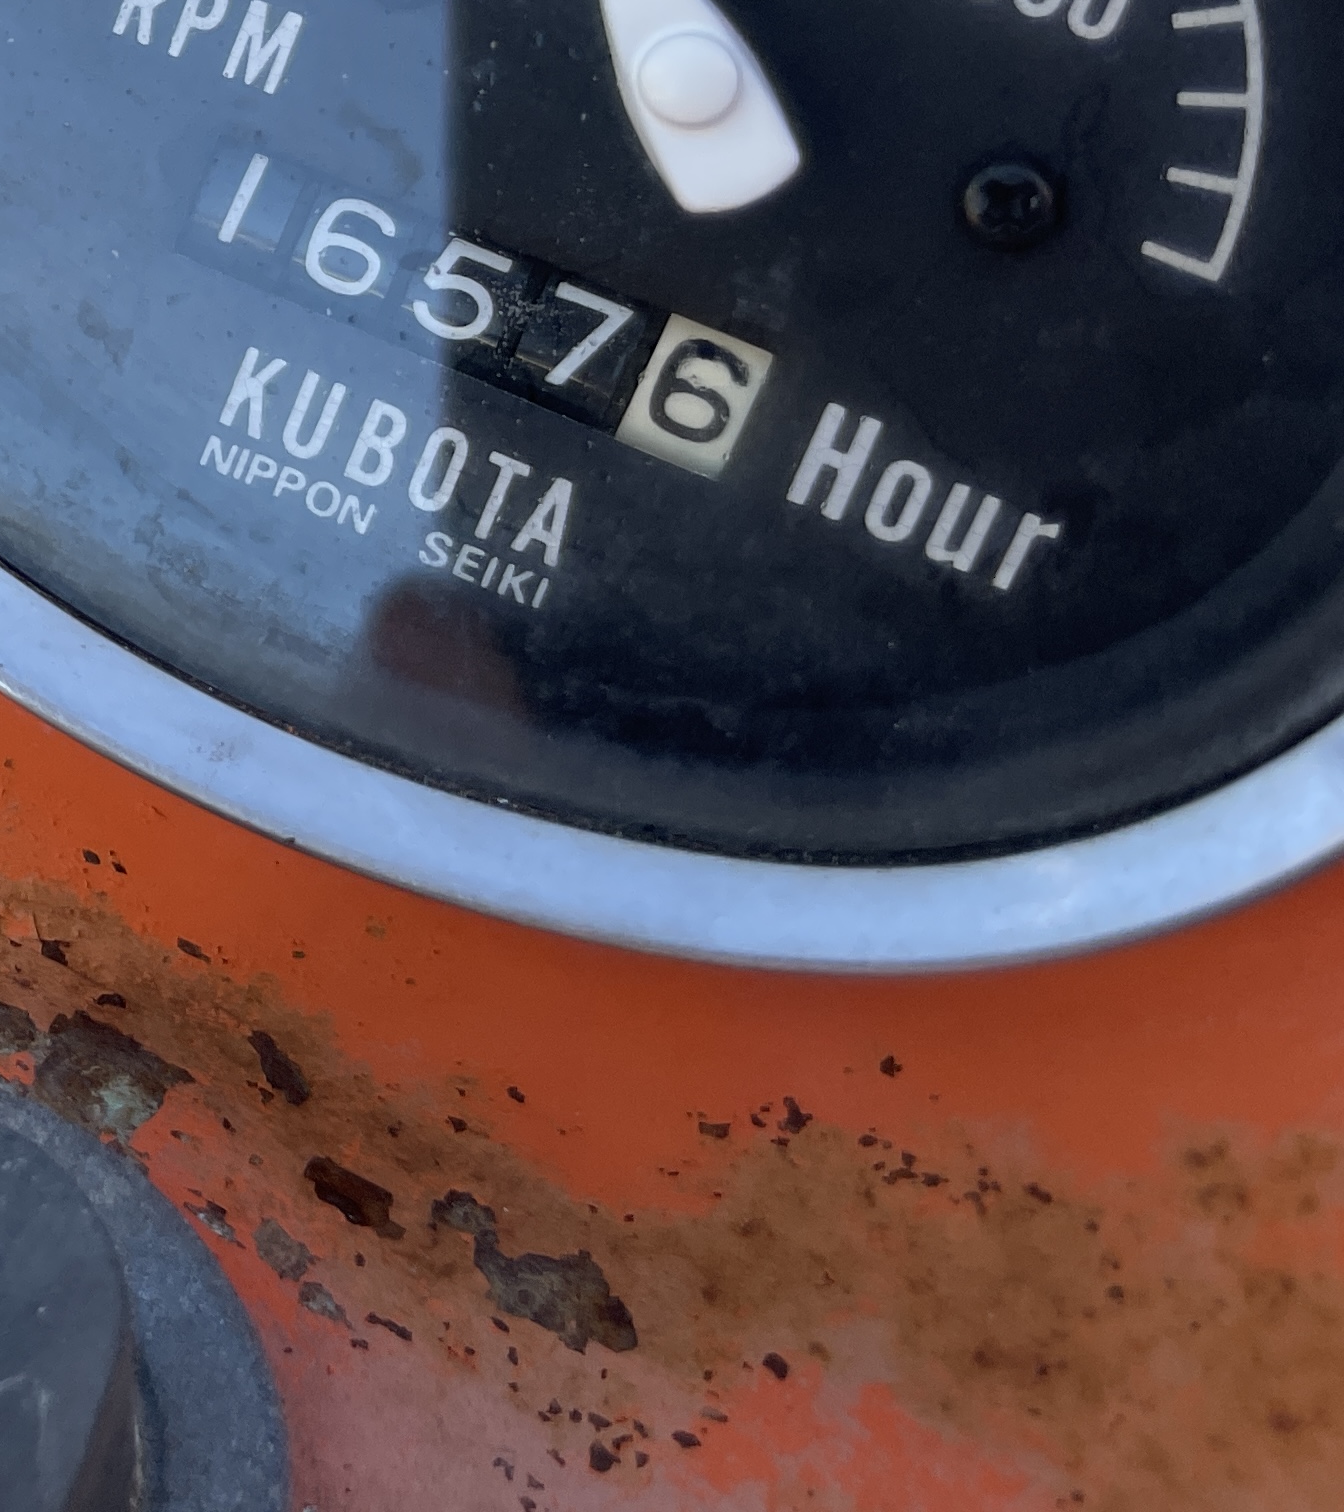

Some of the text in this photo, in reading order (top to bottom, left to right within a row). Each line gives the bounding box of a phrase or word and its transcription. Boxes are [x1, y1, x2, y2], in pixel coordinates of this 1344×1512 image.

[199, 435, 551, 609] NIPPON SEIKI
[218, 346, 575, 567] KUBOTA
[786, 402, 1060, 591] Hour
